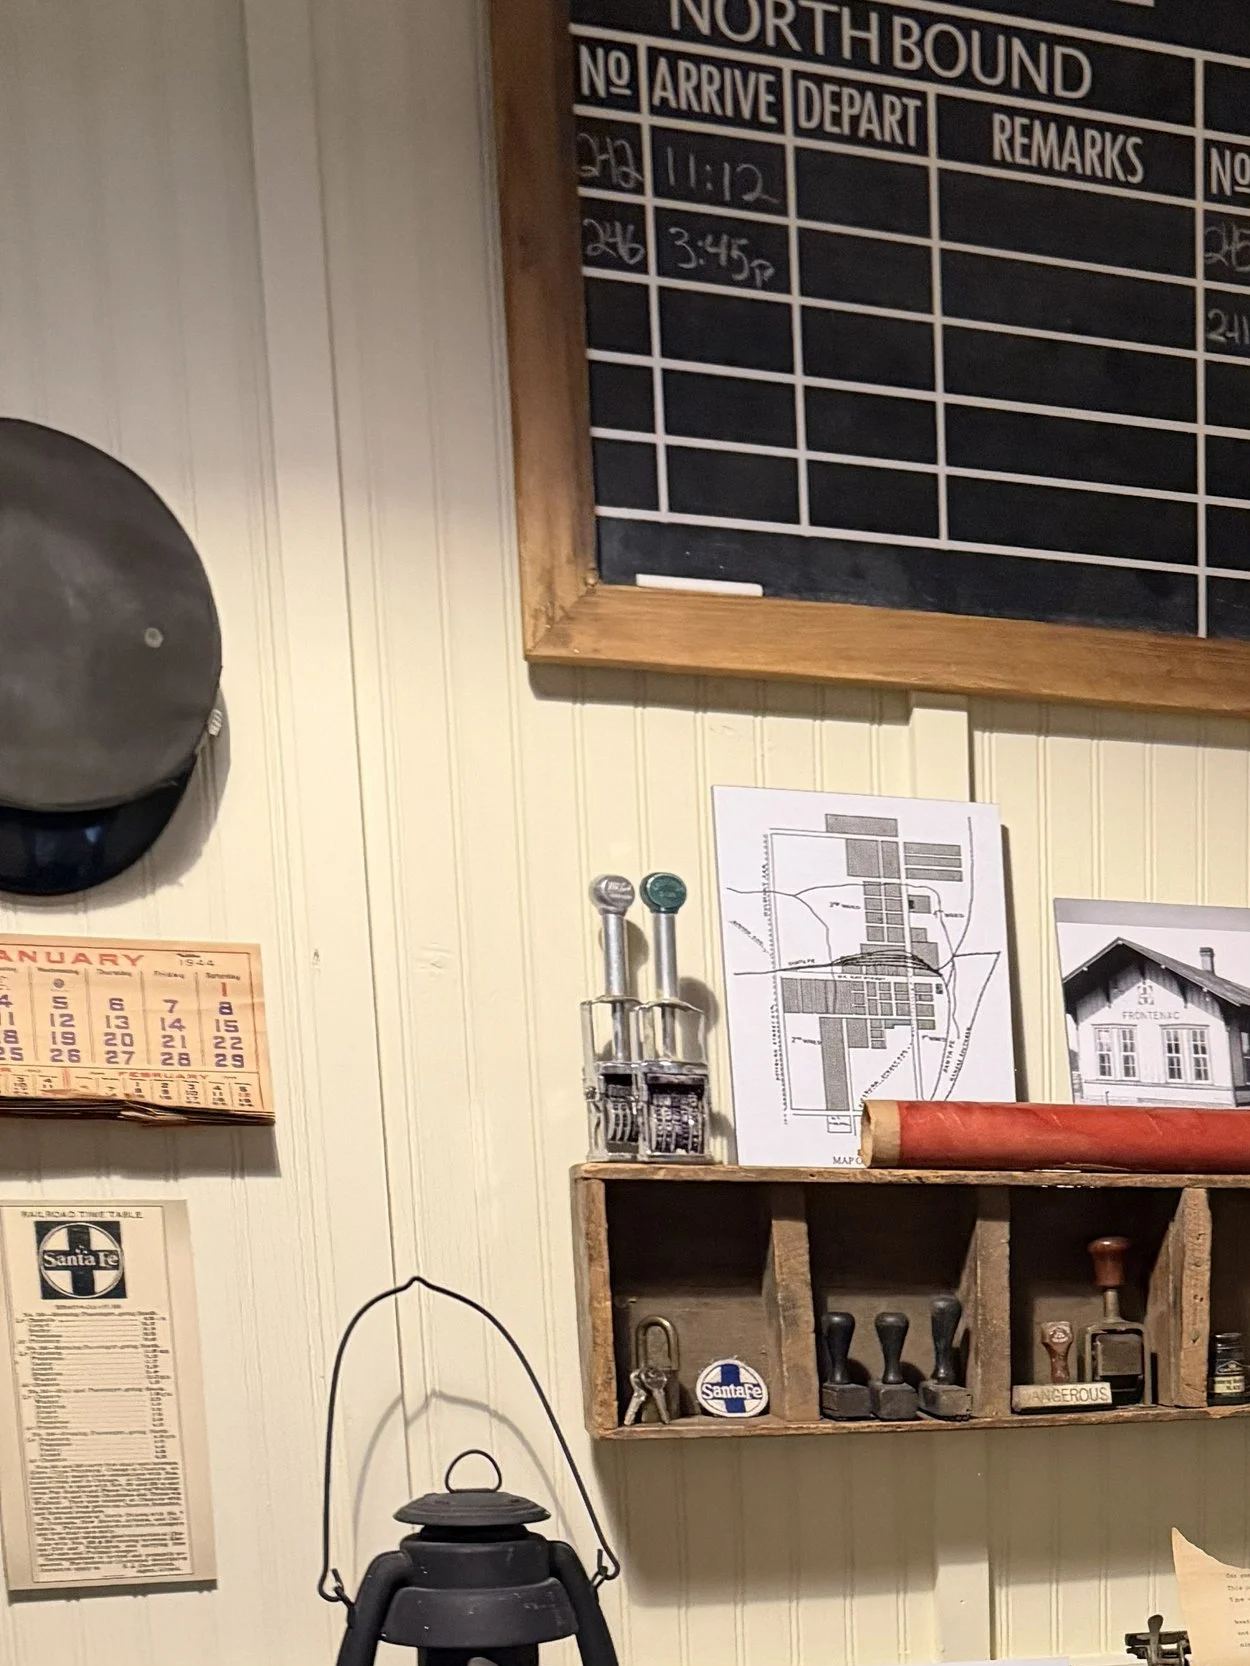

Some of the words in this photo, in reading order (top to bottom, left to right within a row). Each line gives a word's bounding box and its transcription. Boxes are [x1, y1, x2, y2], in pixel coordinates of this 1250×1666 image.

[652, 57, 778, 124] ARRIVE
[797, 80, 921, 147] DEPART
[992, 113, 1144, 184] REMARKS
[667, 146, 779, 203] 11:12
[583, 219, 645, 264] 246
[221, 982, 228, 997] 1
[52, 996, 68, 1009] 5
[109, 998, 124, 1011] 6
[162, 999, 178, 1013] 7
[219, 1001, 233, 1015] 8
[50, 1013, 75, 1027] 12
[105, 1015, 130, 1029] 13
[160, 1017, 186, 1031] 14
[215, 1019, 239, 1032] 15
[1122, 1011, 1180, 1021] FRONTENAC
[51, 1031, 76, 1045] 19
[103, 1032, 134, 1046] 20
[161, 1034, 186, 1048] 21
[213, 1035, 243, 1050] 22
[50, 1048, 80, 1063] 26
[105, 1050, 135, 1064] 27
[161, 1052, 191, 1066] 28
[214, 1053, 244, 1068] 29
[833, 1156, 854, 1165] MAP
[20, 1210, 76, 1219] RAILROAD
[109, 1210, 143, 1219] TABLE
[43, 1252, 96, 1268] Santa
[99, 1252, 119, 1268] Fe
